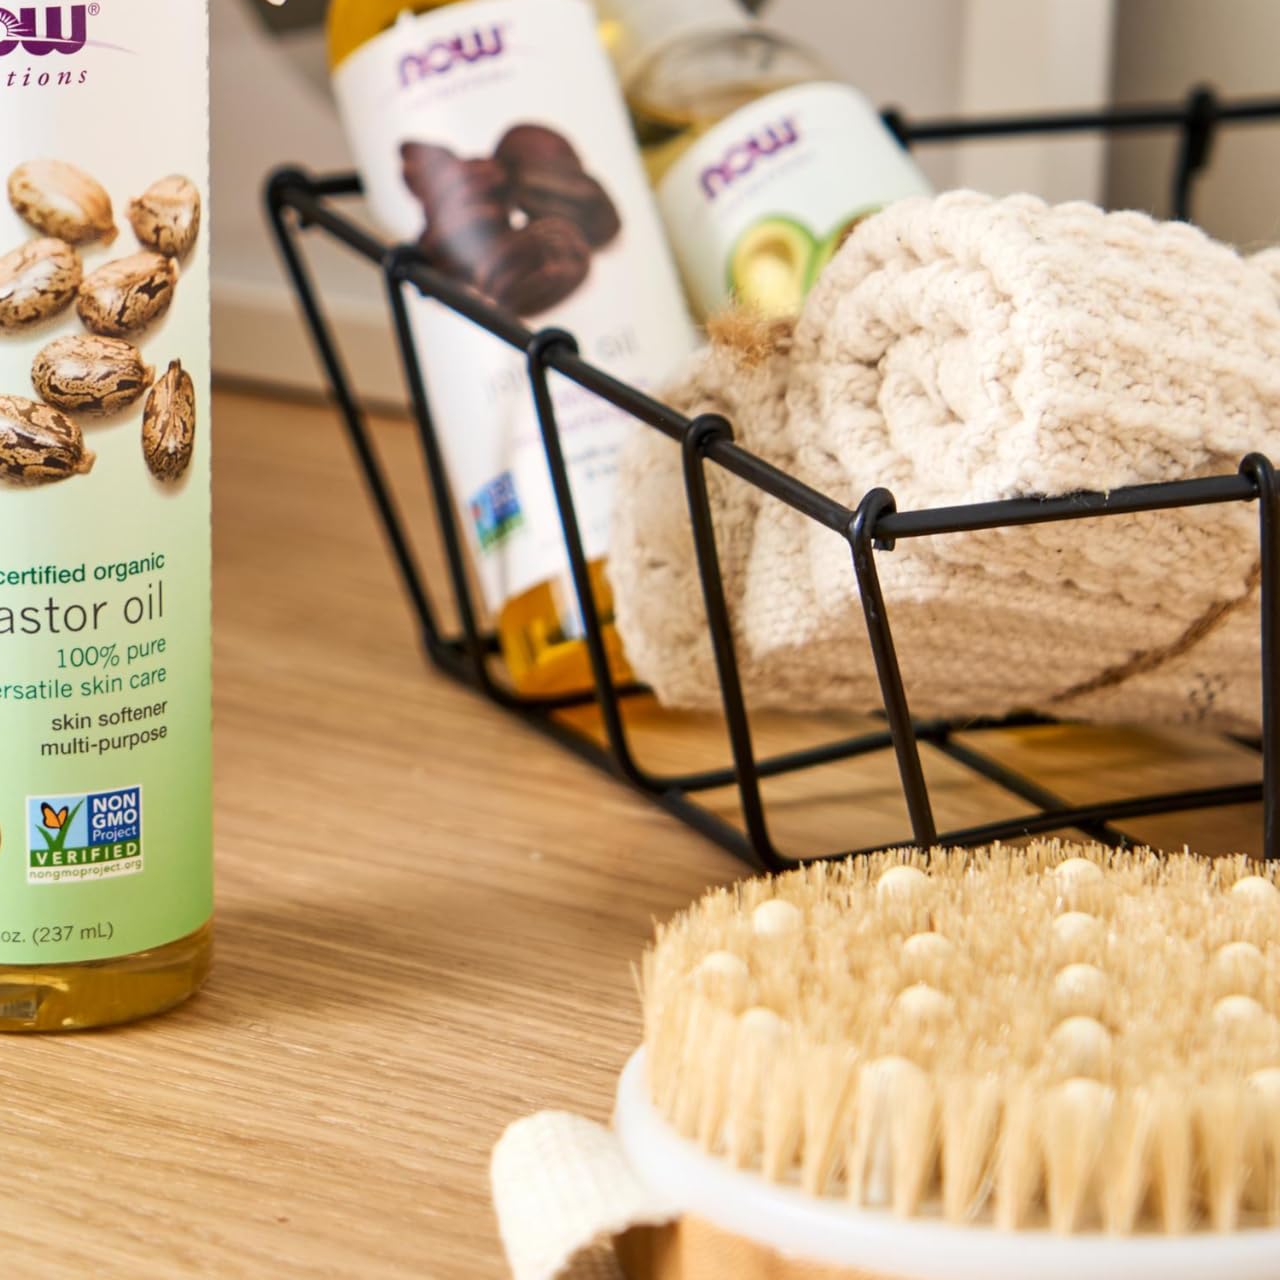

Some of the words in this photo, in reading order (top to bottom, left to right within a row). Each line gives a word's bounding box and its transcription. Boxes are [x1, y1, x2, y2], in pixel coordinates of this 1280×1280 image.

[93, 552, 166, 582] organic
[123, 580, 163, 625] oil
[56, 643, 120, 669] 100%
[127, 637, 167, 664] pure
[80, 675, 123, 697] skin
[129, 666, 167, 690] care
[51, 712, 92, 732] skin
[97, 700, 168, 728] softener
[40, 723, 168, 756] multi-purpose
[92, 792, 137, 814] NON
[91, 809, 138, 830] GMO
[92, 824, 137, 843] Project
[36, 842, 138, 866] VERIFIED
[29, 858, 143, 881] nongmoproject.org
[0, 929, 26, 943] oz.
[32, 925, 74, 946] (237
[80, 921, 114, 940] mL)
